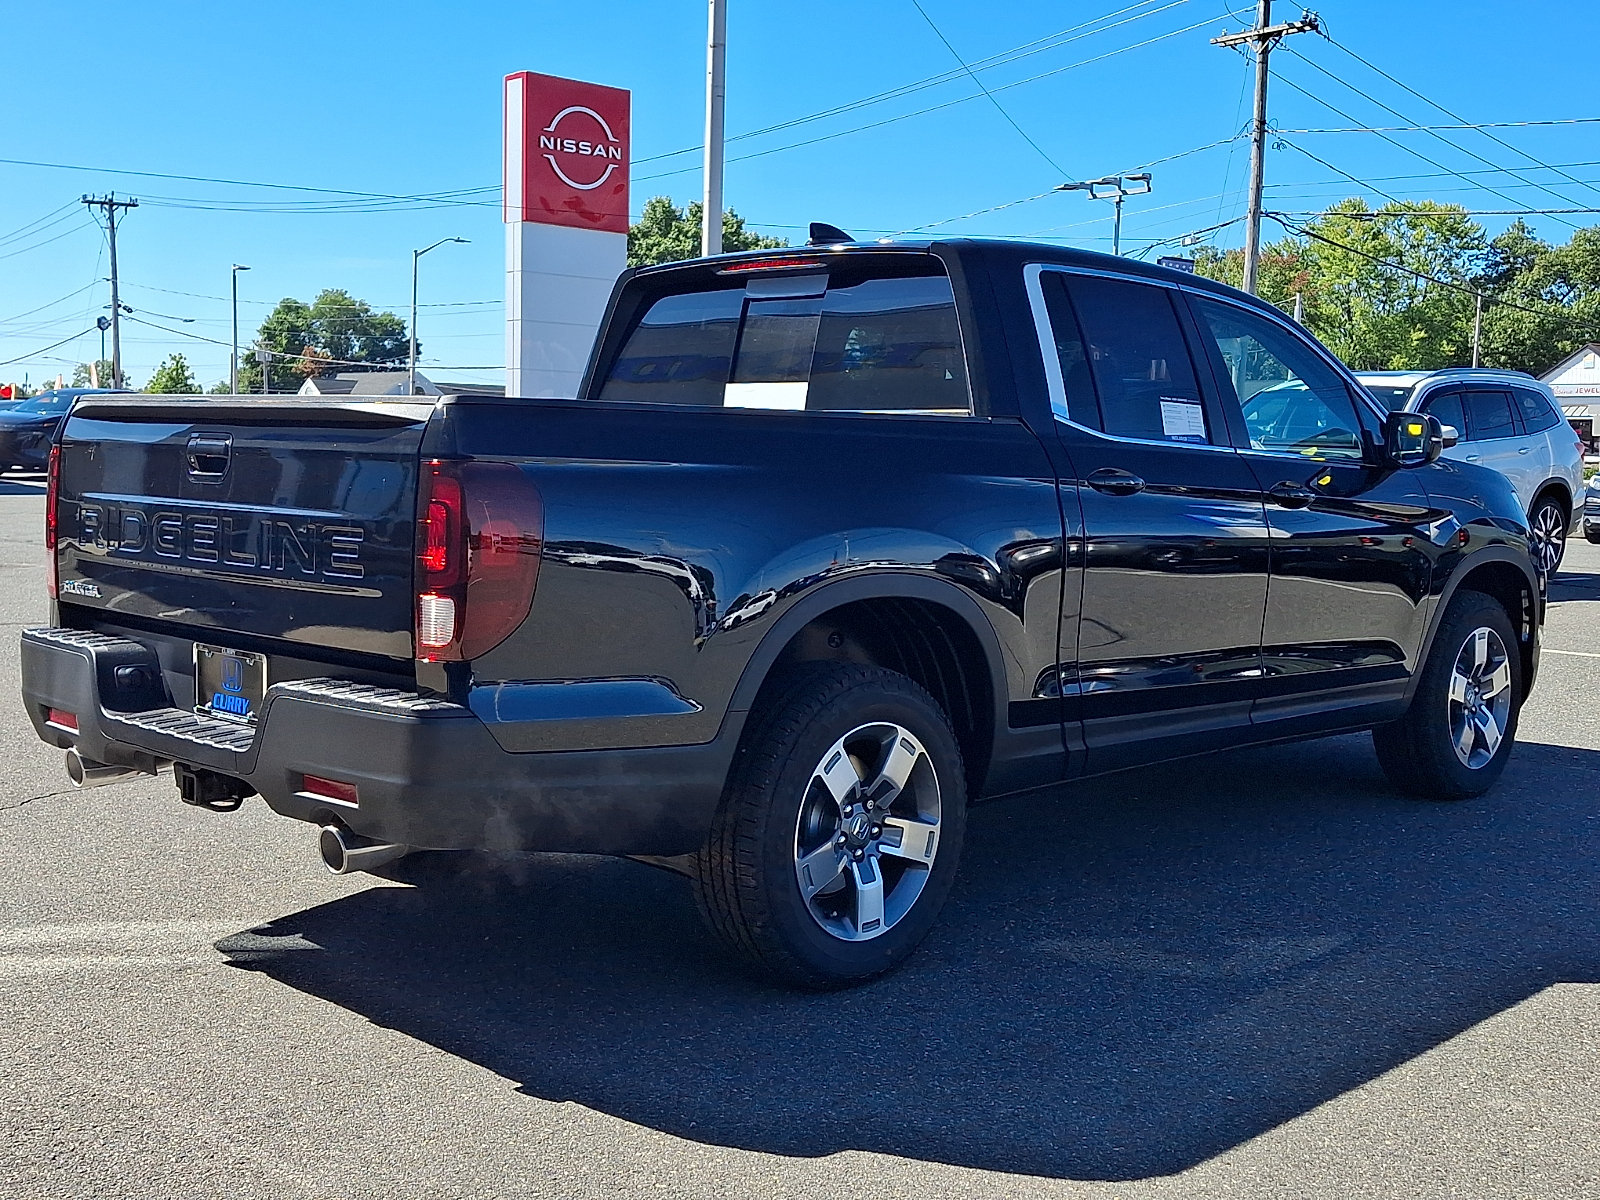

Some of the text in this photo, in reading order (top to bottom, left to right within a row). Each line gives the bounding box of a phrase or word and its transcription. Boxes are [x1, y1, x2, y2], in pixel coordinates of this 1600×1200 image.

[539, 135, 622, 160] NISSAN
[77, 502, 365, 579] RIDGELINE
[213, 692, 249, 715] CURRY
